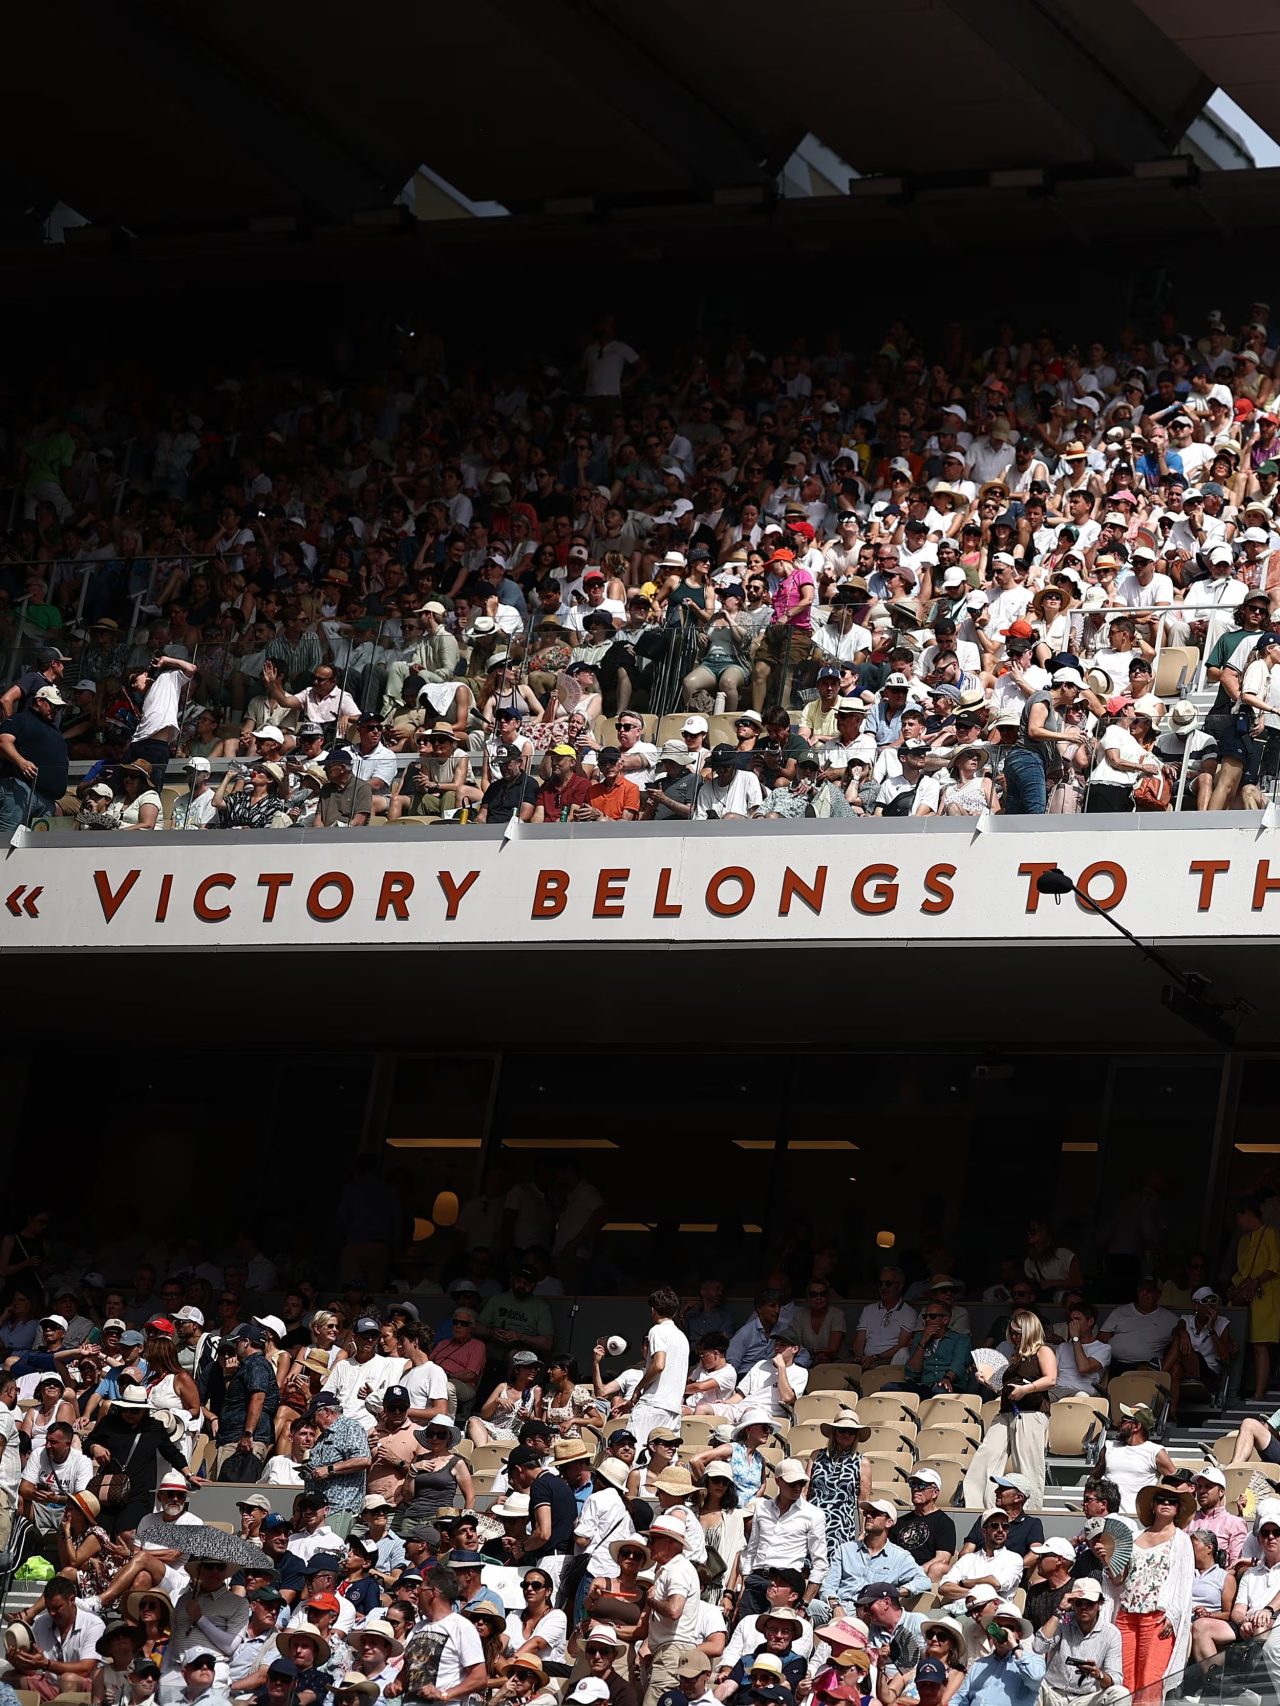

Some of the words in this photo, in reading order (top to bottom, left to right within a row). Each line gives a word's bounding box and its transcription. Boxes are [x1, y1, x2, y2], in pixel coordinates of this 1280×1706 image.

[94, 867, 480, 922] VICTORY
[532, 862, 957, 916] BELONGS
[1018, 860, 1128, 914] TO
